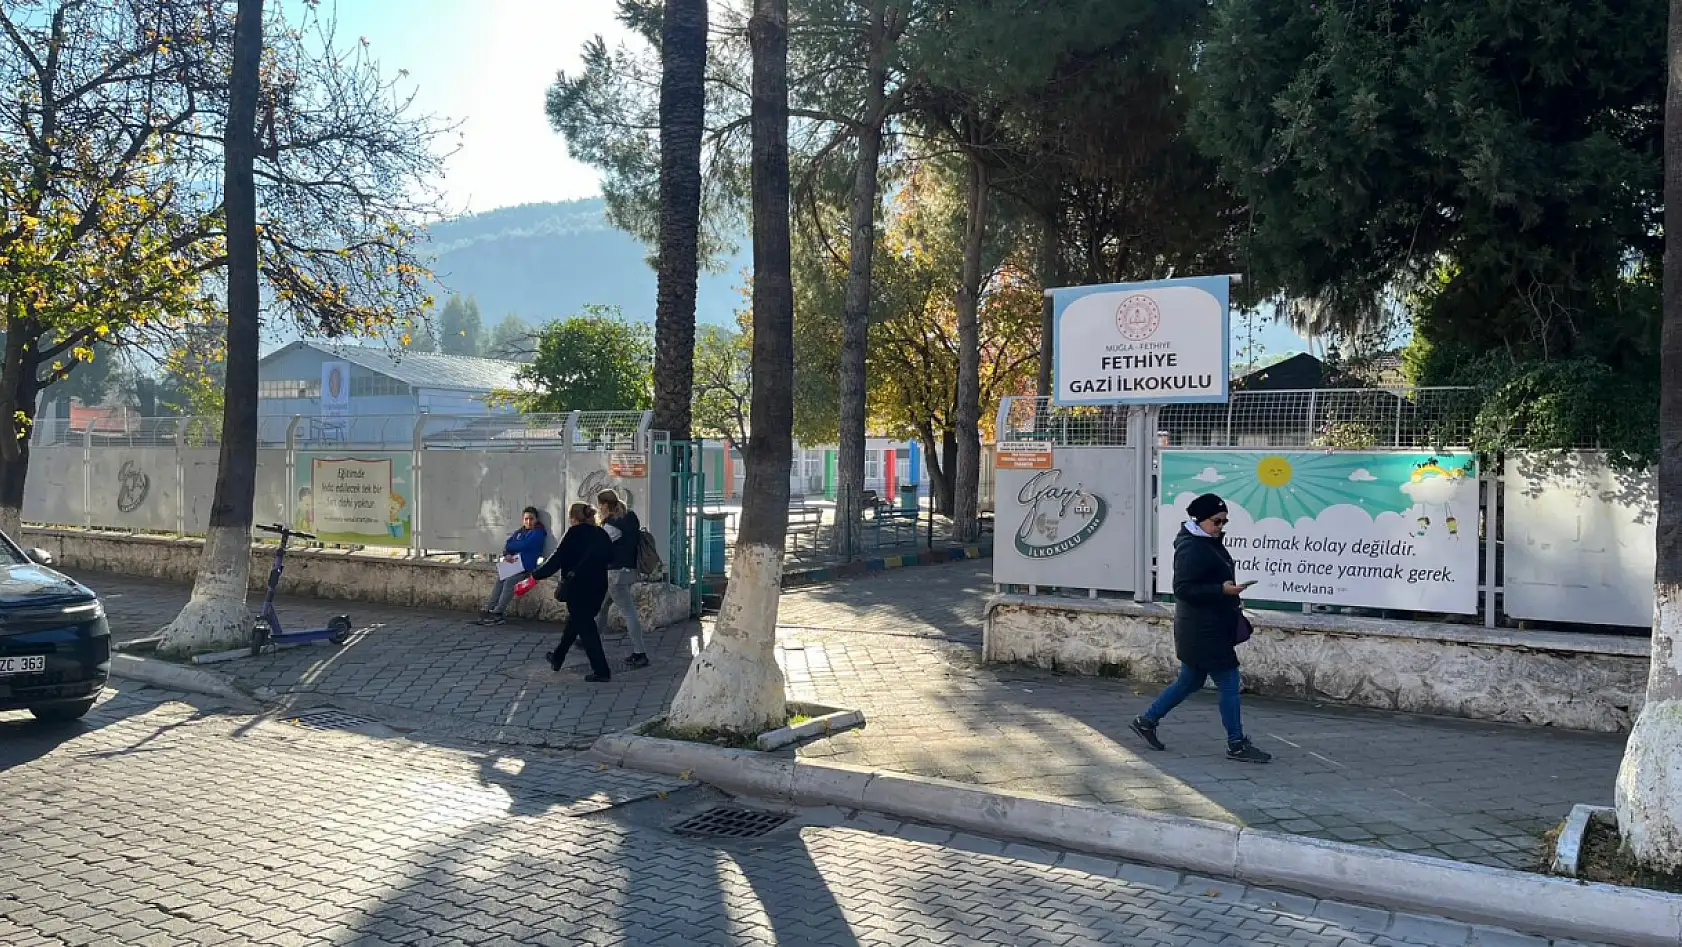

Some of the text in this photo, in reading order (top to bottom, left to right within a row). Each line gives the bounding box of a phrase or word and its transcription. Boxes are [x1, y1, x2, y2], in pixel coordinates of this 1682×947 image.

[1101, 352, 1178, 371] FETHİYE
[1069, 374, 1212, 393] GAZİ İLKOKULU
[1028, 536, 1081, 556] İLKOKULU
[1224, 534, 1416, 558] um olmak kolay değildir.
[1264, 557, 1292, 576] için
[1297, 560, 1333, 575] önce
[1337, 563, 1403, 579] yanmak
[1407, 566, 1455, 584] gerek.
[1282, 581, 1334, 596] Mevlana
[20, 657, 44, 670] 363
